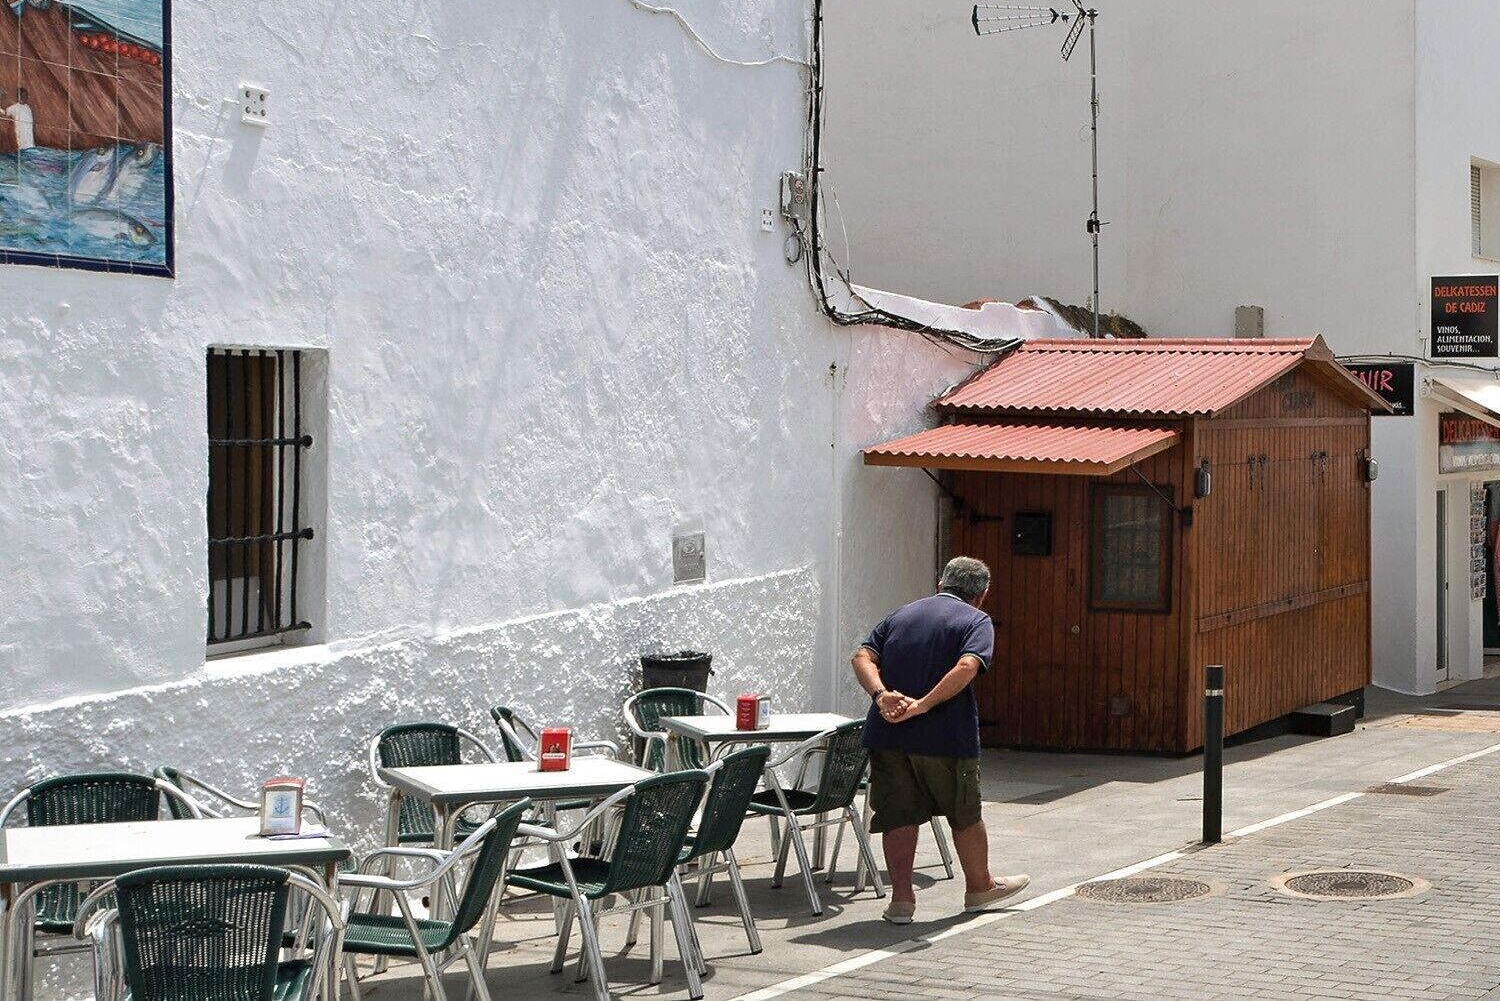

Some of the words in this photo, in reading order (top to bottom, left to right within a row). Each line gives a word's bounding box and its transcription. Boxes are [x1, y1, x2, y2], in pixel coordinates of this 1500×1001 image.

[1434, 285, 1497, 297] DELICATESSEN
[1445, 302, 1457, 313] DE
[1460, 301, 1486, 313] CADIZ
[1437, 326, 1461, 334] VINOS,
[1437, 335, 1493, 343] ALIMENTACION,
